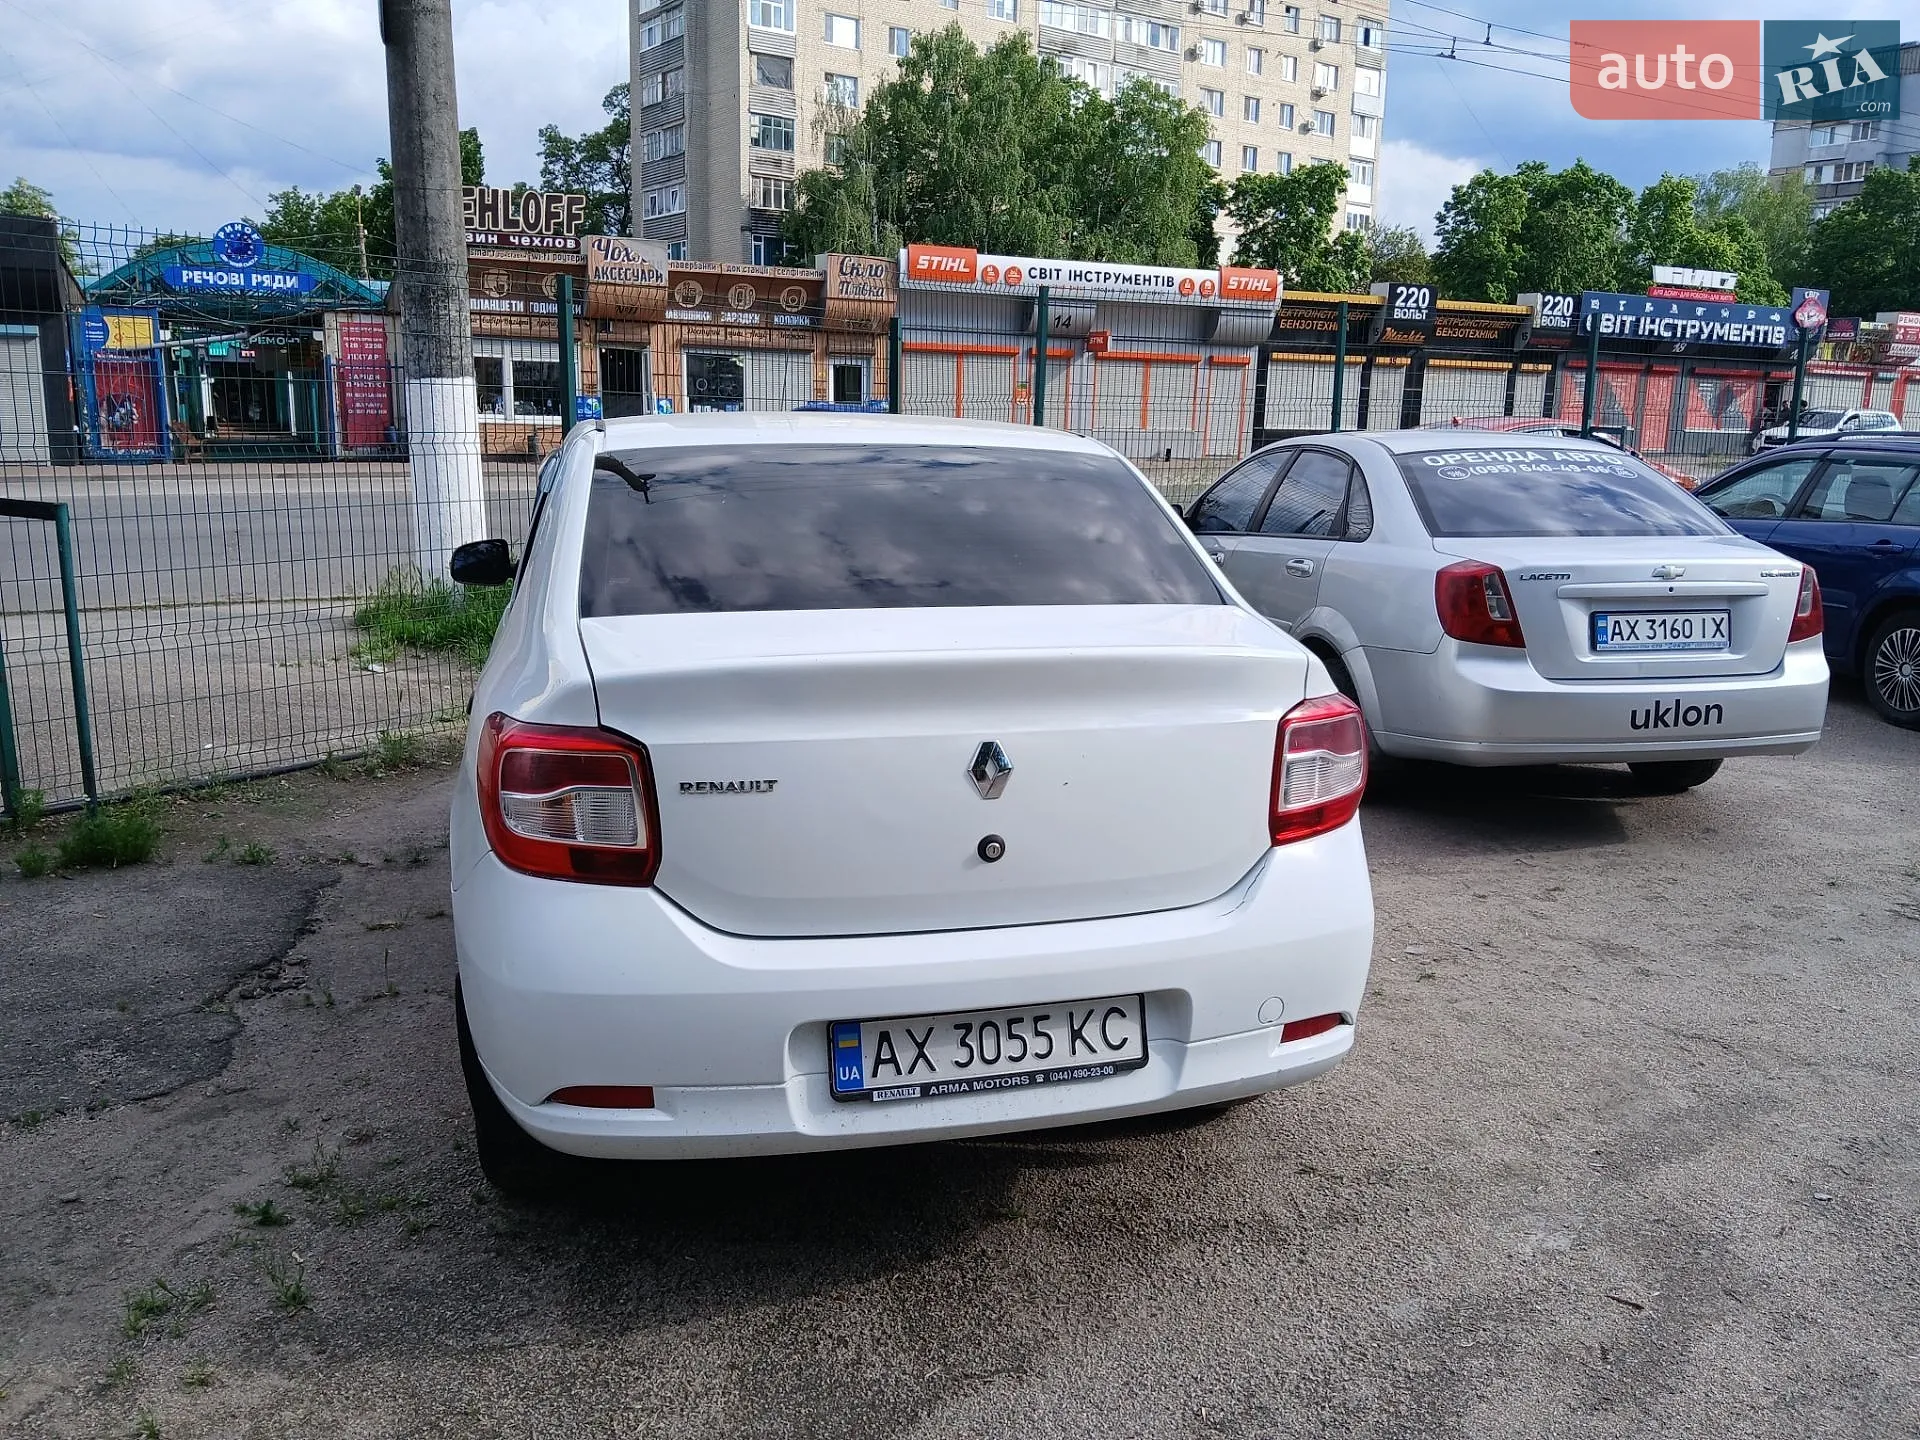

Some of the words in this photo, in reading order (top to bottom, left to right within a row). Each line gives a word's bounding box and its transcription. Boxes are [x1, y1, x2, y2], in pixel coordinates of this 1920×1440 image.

[218, 223, 260, 241] РИНОК
[840, 255, 885, 278] Скло
[917, 255, 970, 273] STIHL
[182, 269, 245, 286] РЕЧОВІ
[251, 273, 299, 290] РЯДИ
[594, 266, 664, 283] АКСЕСУАРИ
[1028, 266, 1062, 281] СВІТ
[1068, 269, 1175, 288] ІНСТРУМЕНТІВ
[1226, 276, 1273, 292] STIHL
[470, 299, 524, 312] ПЛАНШЕТИ
[1395, 286, 1430, 308] 220
[1542, 295, 1574, 316] 220
[720, 312, 761, 324] ЗАРЯДКИ
[1053, 315, 1072, 329] 14
[1393, 308, 1429, 320] ВОЛЬТ
[1541, 315, 1573, 328] ВОЛЬТ
[1898, 315, 1920, 325] РЕМО
[1436, 327, 1499, 340] БЕНЗОТЕХНІКА
[1637, 316, 1786, 345] ІНСТРУМЕНТІВ
[1422, 450, 1548, 466] ОРЕНДА
[1552, 451, 1623, 465] АВТО
[1470, 464, 1517, 476] (095)
[1520, 464, 1609, 474] 640-49-06
[1597, 633, 1608, 642] UA
[1610, 619, 1640, 642] AX
[1646, 618, 1693, 641] 3160
[1702, 617, 1726, 639] IX
[1630, 699, 1723, 731] uklon
[679, 778, 779, 795] RENAULT
[871, 1026, 938, 1078] AX
[953, 1014, 1055, 1068] 3055
[1069, 1006, 1129, 1057] KC
[839, 1065, 860, 1081] UA
[877, 1086, 917, 1100] RENAULT
[929, 1082, 970, 1096] ARMA
[973, 1074, 1030, 1091] MOTORS
[1049, 1071, 1072, 1082] (044)
[1072, 1065, 1114, 1079] 490-23-00
